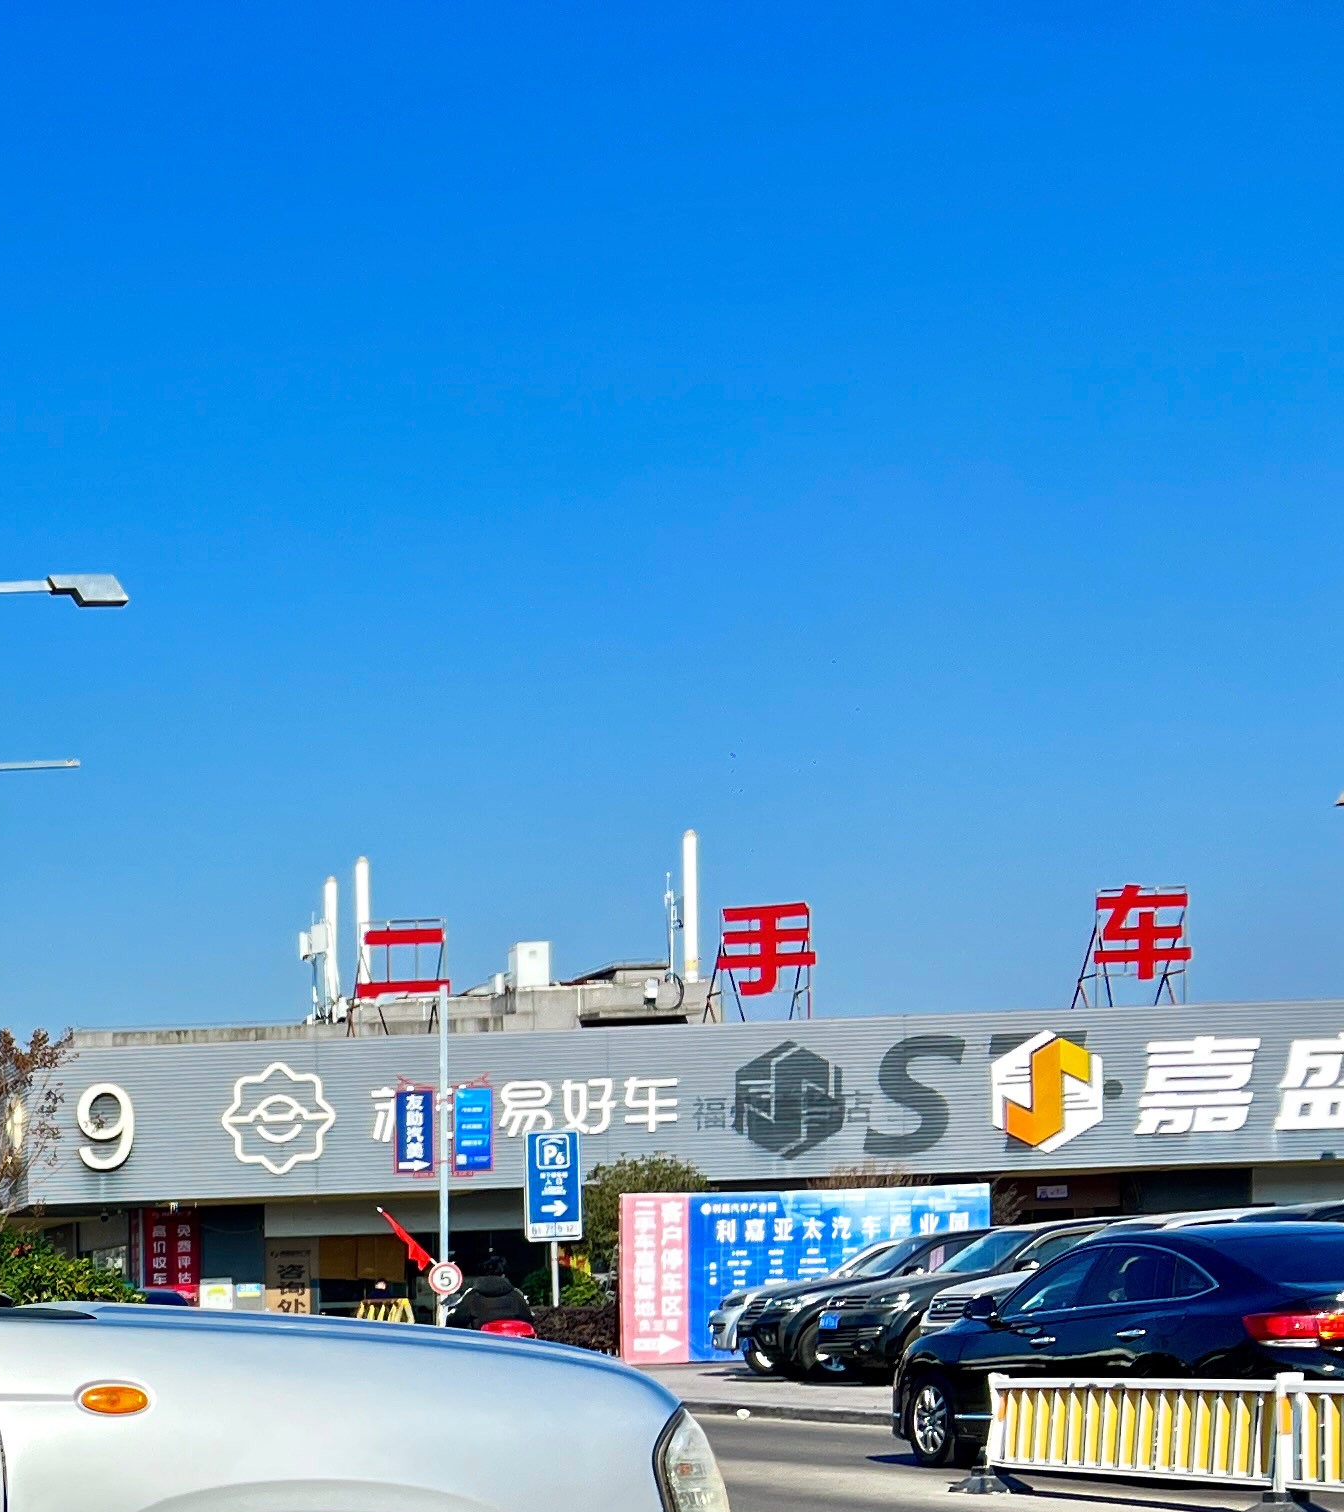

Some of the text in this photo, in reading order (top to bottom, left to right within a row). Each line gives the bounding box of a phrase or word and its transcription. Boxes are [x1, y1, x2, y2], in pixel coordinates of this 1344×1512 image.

[77, 1083, 134, 1171] 9
[152, 1225, 168, 1286] 高价收车
[177, 1224, 192, 1284] 免费评估
[716, 1211, 970, 1244] 利嘉亚太汽车产业园
[439, 1270, 453, 1288] 5
[661, 1200, 683, 1317] 客户停车区
